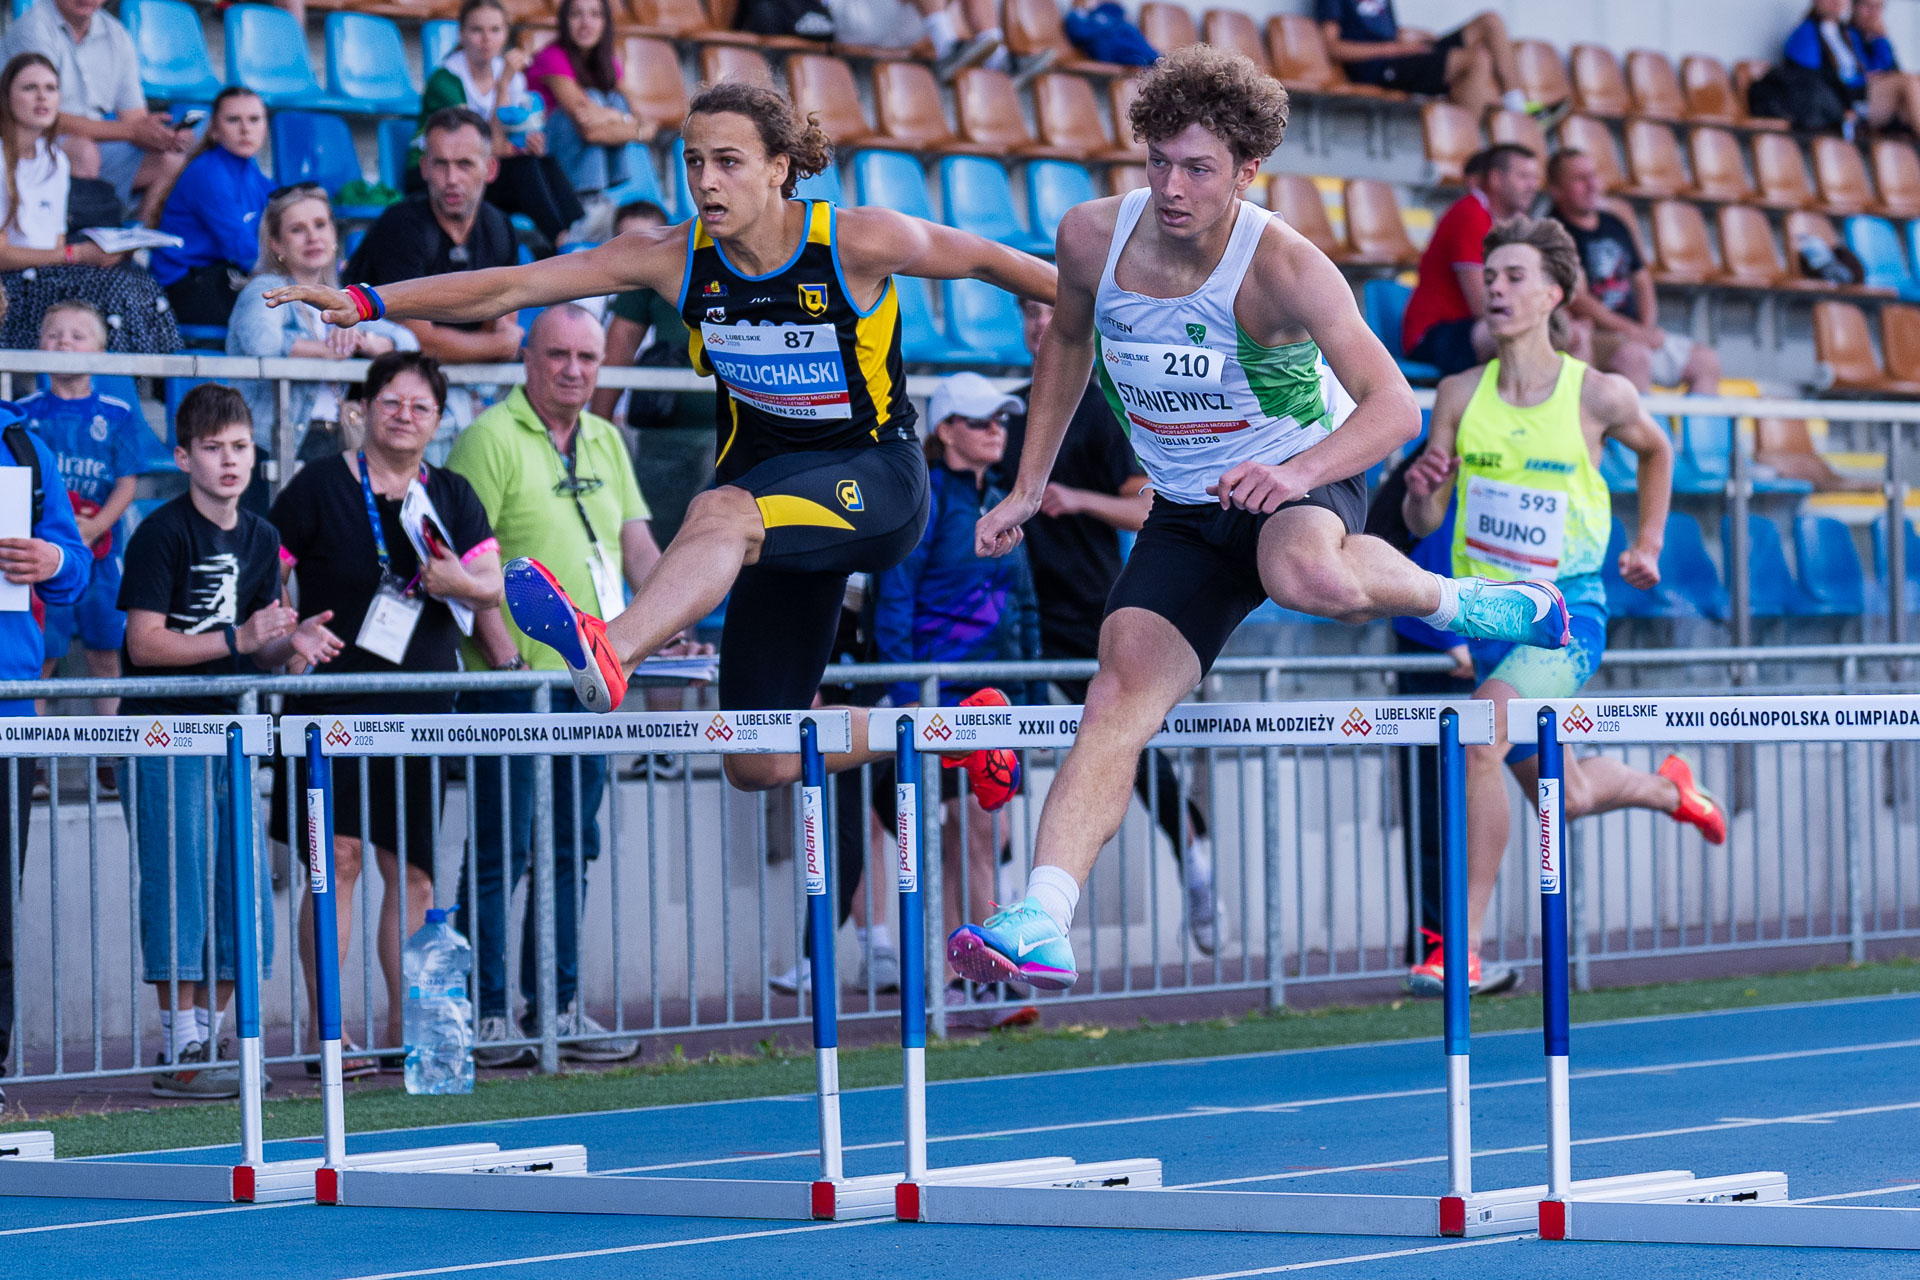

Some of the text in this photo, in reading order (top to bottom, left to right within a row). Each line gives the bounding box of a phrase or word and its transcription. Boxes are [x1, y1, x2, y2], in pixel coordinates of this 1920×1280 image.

[725, 334, 761, 342] LUBELSKIE
[784, 331, 815, 349] 87
[1118, 351, 1150, 362] LUBELSKIE
[1163, 352, 1210, 378] 210
[714, 360, 839, 386] BRZUCHALSKI
[1117, 381, 1233, 413] STANIEWICZ
[753, 401, 817, 417] LUBLIN 2026
[1155, 435, 1220, 446] LUBLIN 2026
[1519, 492, 1557, 514] 593
[1478, 514, 1546, 546] BUJNO
[1375, 707, 1436, 720] LUBELSKIE
[1597, 704, 1658, 717] LUBELSKIE
[1665, 706, 1919, 726] XXXII OGÓLNOPOLSKA OLIMPIADA
[736, 713, 792, 726] LUBELSKIE
[955, 713, 1012, 726] LUBELSKIE
[1174, 717, 1251, 734] OLIMPIADA
[1256, 713, 1335, 732] MŁODZIEŻY
[1597, 720, 1620, 732] 2026
[6, 727, 70, 741] OLIMPIADA
[75, 725, 140, 742] MŁODZIEŻY
[173, 722, 225, 735] LUBELSKIE
[354, 721, 405, 733] LUBELSKIE
[411, 720, 699, 742] XXXII OGÓLNOPOLSKA OLIMPIADA MŁODZIEŻY
[1018, 721, 1054, 735] XXXII
[1375, 723, 1398, 735] 2026
[354, 735, 374, 746] 2026
[737, 729, 758, 740] 2026
[955, 729, 977, 740] 2026
[173, 737, 193, 748] 2026
[309, 815, 321, 873] polanik
[804, 814, 820, 874] polanik
[897, 811, 911, 872] polanik
[1540, 807, 1554, 871] polanik
